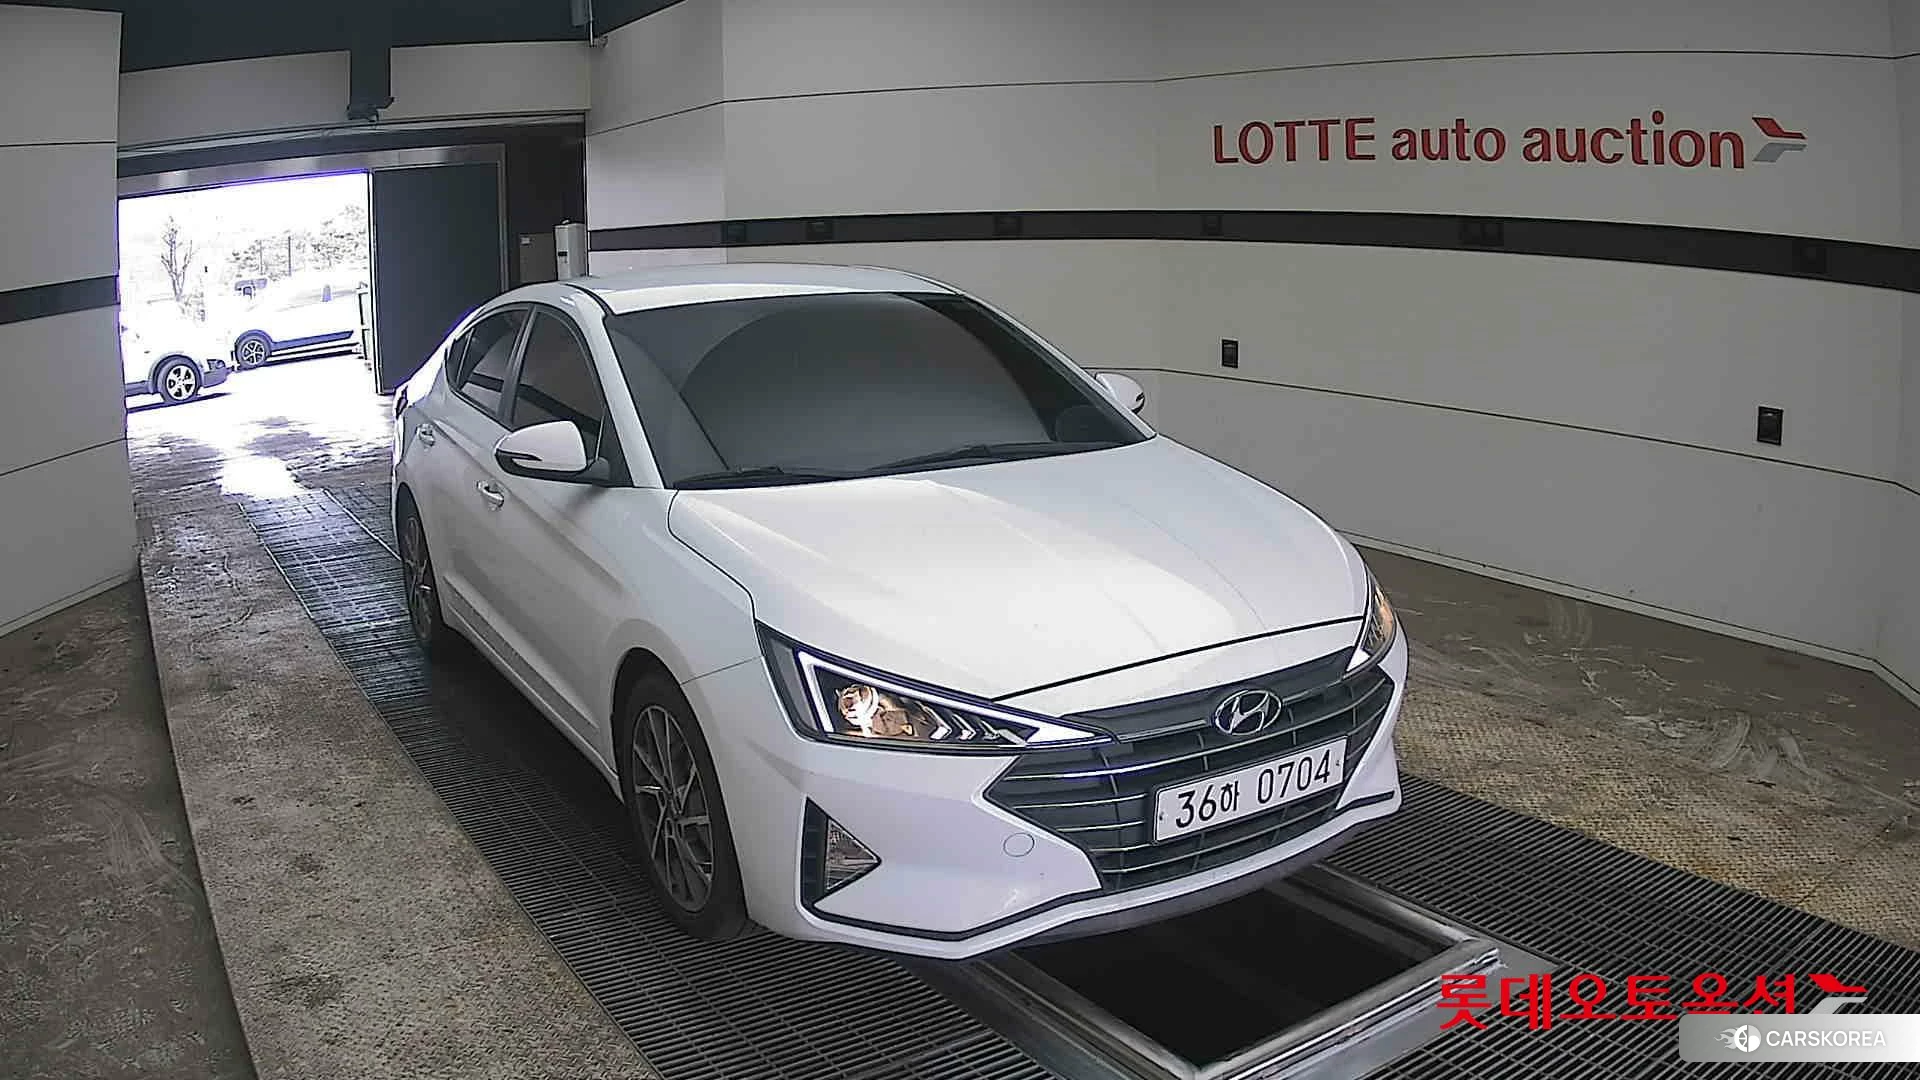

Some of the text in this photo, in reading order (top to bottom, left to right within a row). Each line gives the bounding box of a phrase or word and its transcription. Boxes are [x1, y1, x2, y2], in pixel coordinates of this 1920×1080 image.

[1213, 111, 1745, 169] LOTTE auto auction
[1175, 749, 1330, 828] 36하 0704
